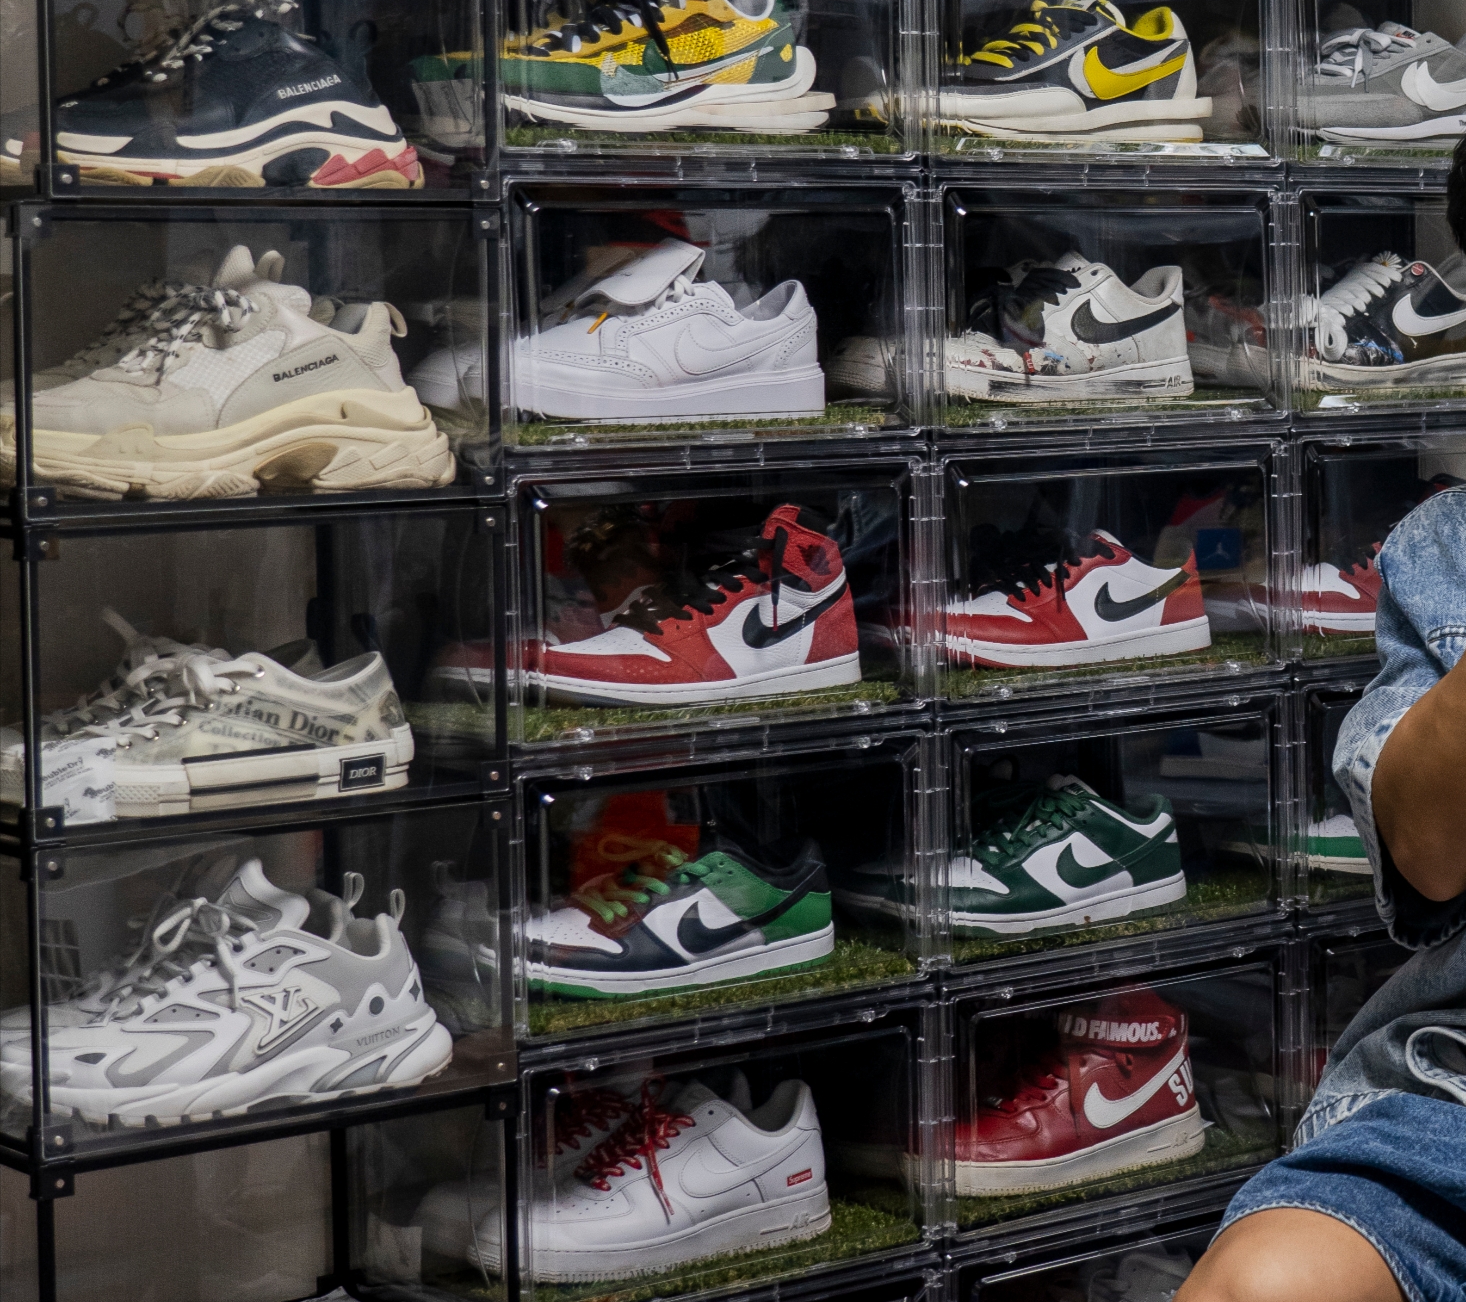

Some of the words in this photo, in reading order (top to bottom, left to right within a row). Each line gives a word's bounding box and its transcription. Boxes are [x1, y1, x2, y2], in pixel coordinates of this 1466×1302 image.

[277, 74, 342, 100] BALENCIAGA
[272, 354, 339, 383] BALENCIAGA
[1165, 374, 1182, 389] AIR
[288, 710, 341, 743] Dior
[42, 756, 84, 784] oubleDry
[349, 764, 377, 781] DIOR
[356, 1026, 400, 1047] VUITTON
